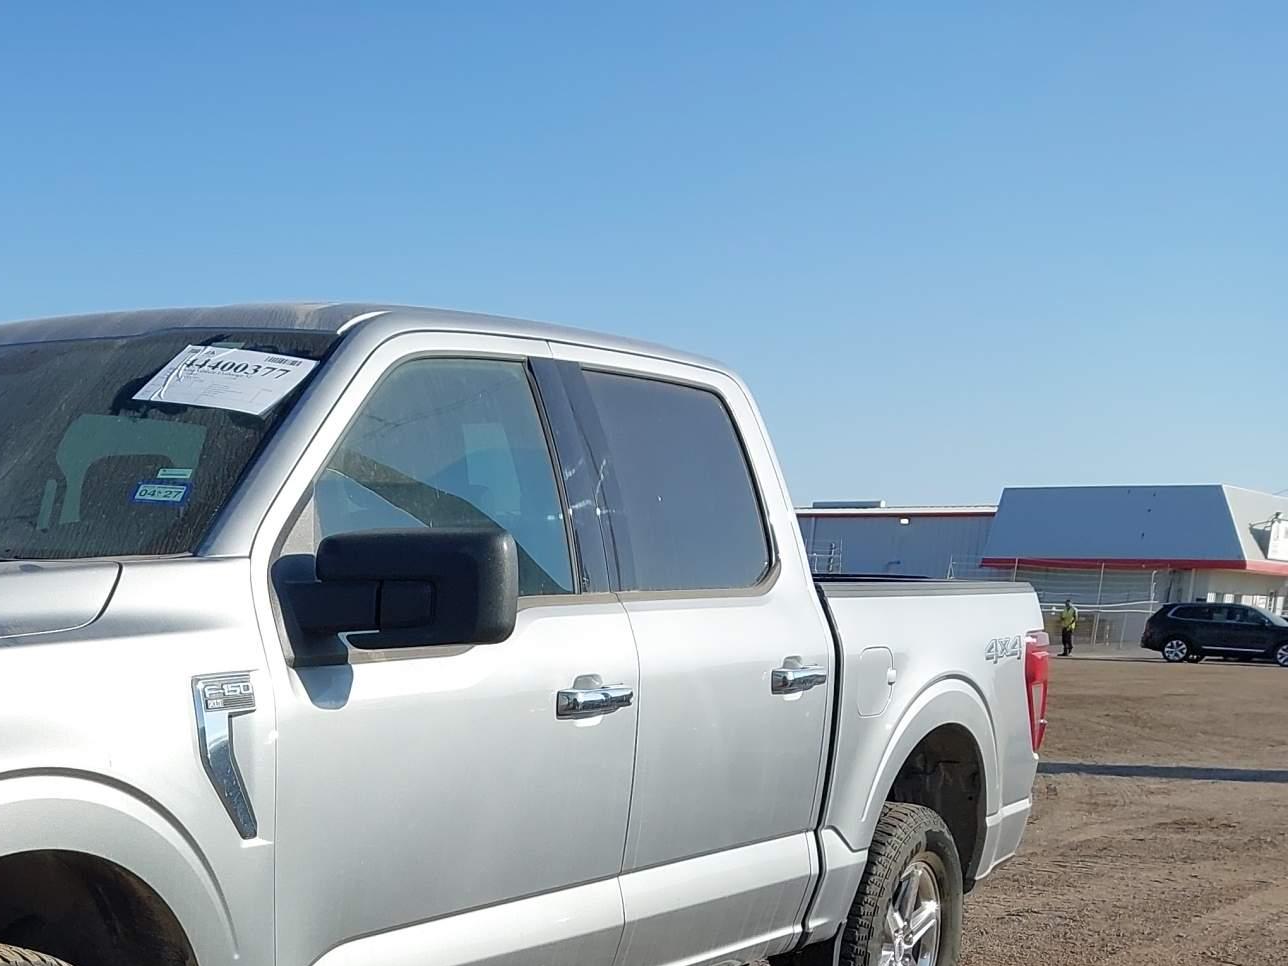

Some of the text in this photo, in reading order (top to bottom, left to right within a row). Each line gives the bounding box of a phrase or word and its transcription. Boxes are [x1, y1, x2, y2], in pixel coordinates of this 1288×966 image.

[185, 358, 291, 379] 44400377
[162, 490, 182, 499] 27
[984, 634, 1022, 664] 4x4
[203, 682, 253, 698] F-150
